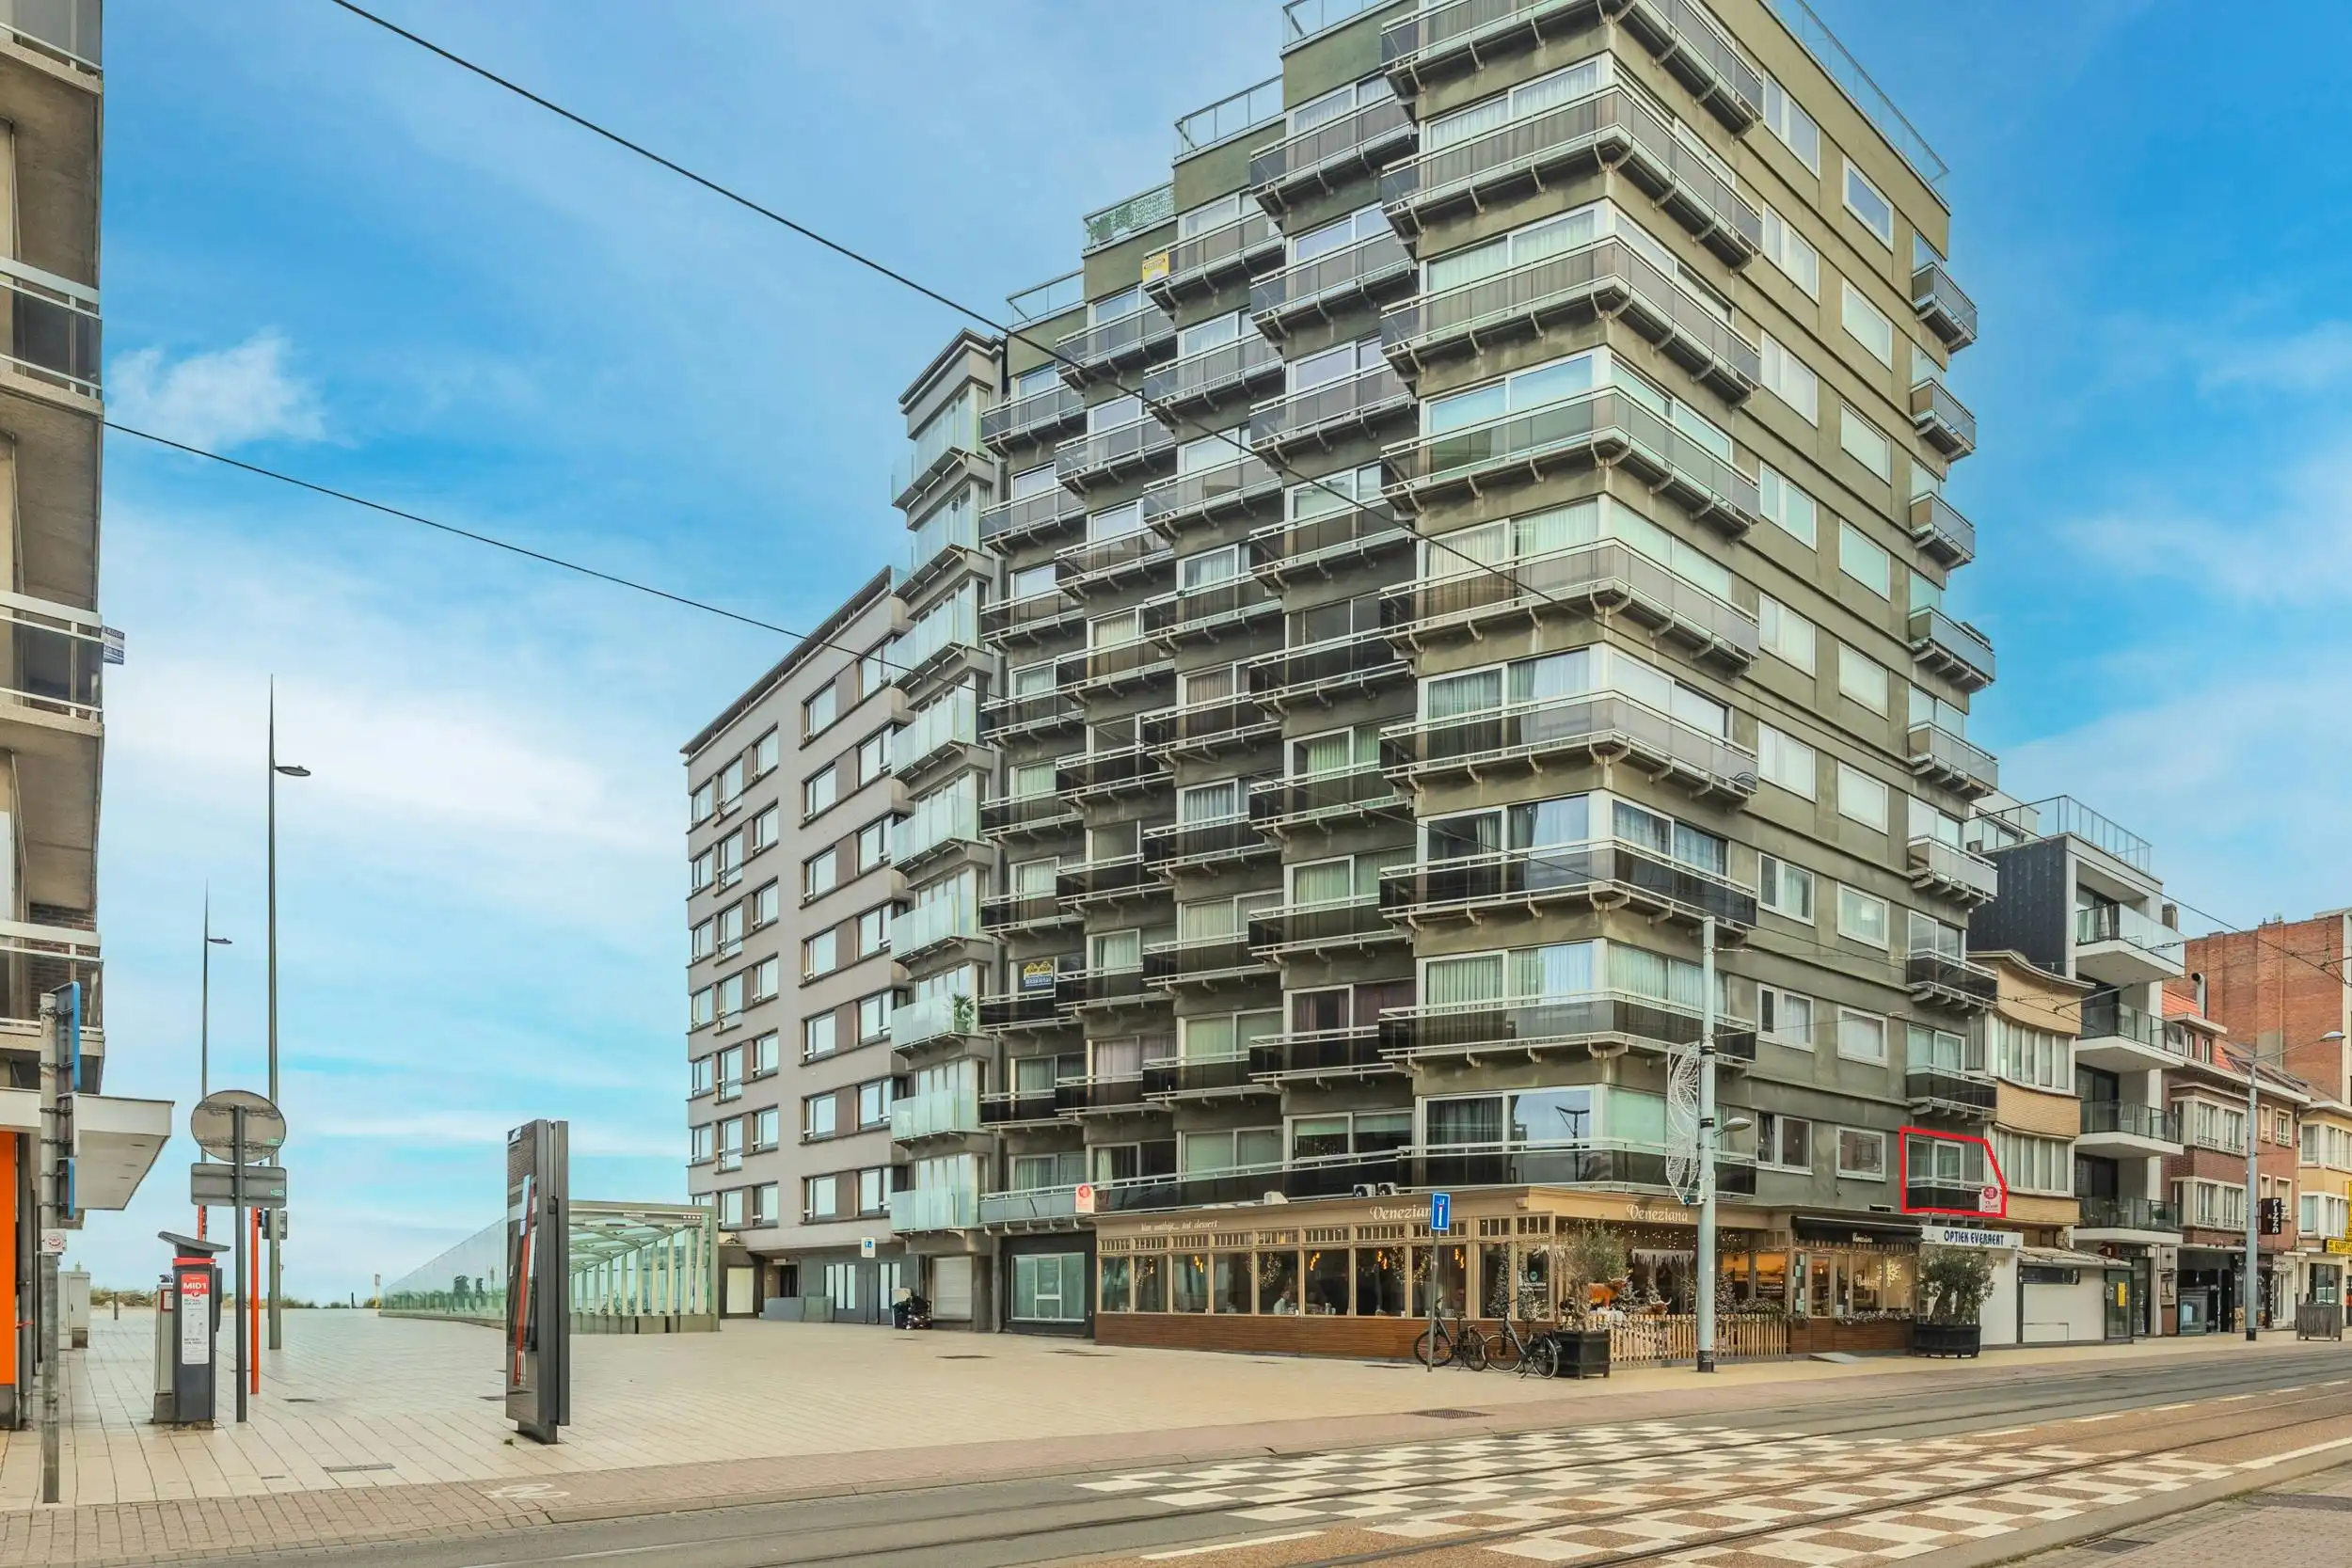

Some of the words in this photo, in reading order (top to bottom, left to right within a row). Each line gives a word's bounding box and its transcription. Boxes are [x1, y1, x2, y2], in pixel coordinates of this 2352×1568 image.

[1370, 1204, 1431, 1220] Venezian
[1627, 1204, 1688, 1222] Veneziana
[1944, 1230, 1969, 1243] OPTIEK
